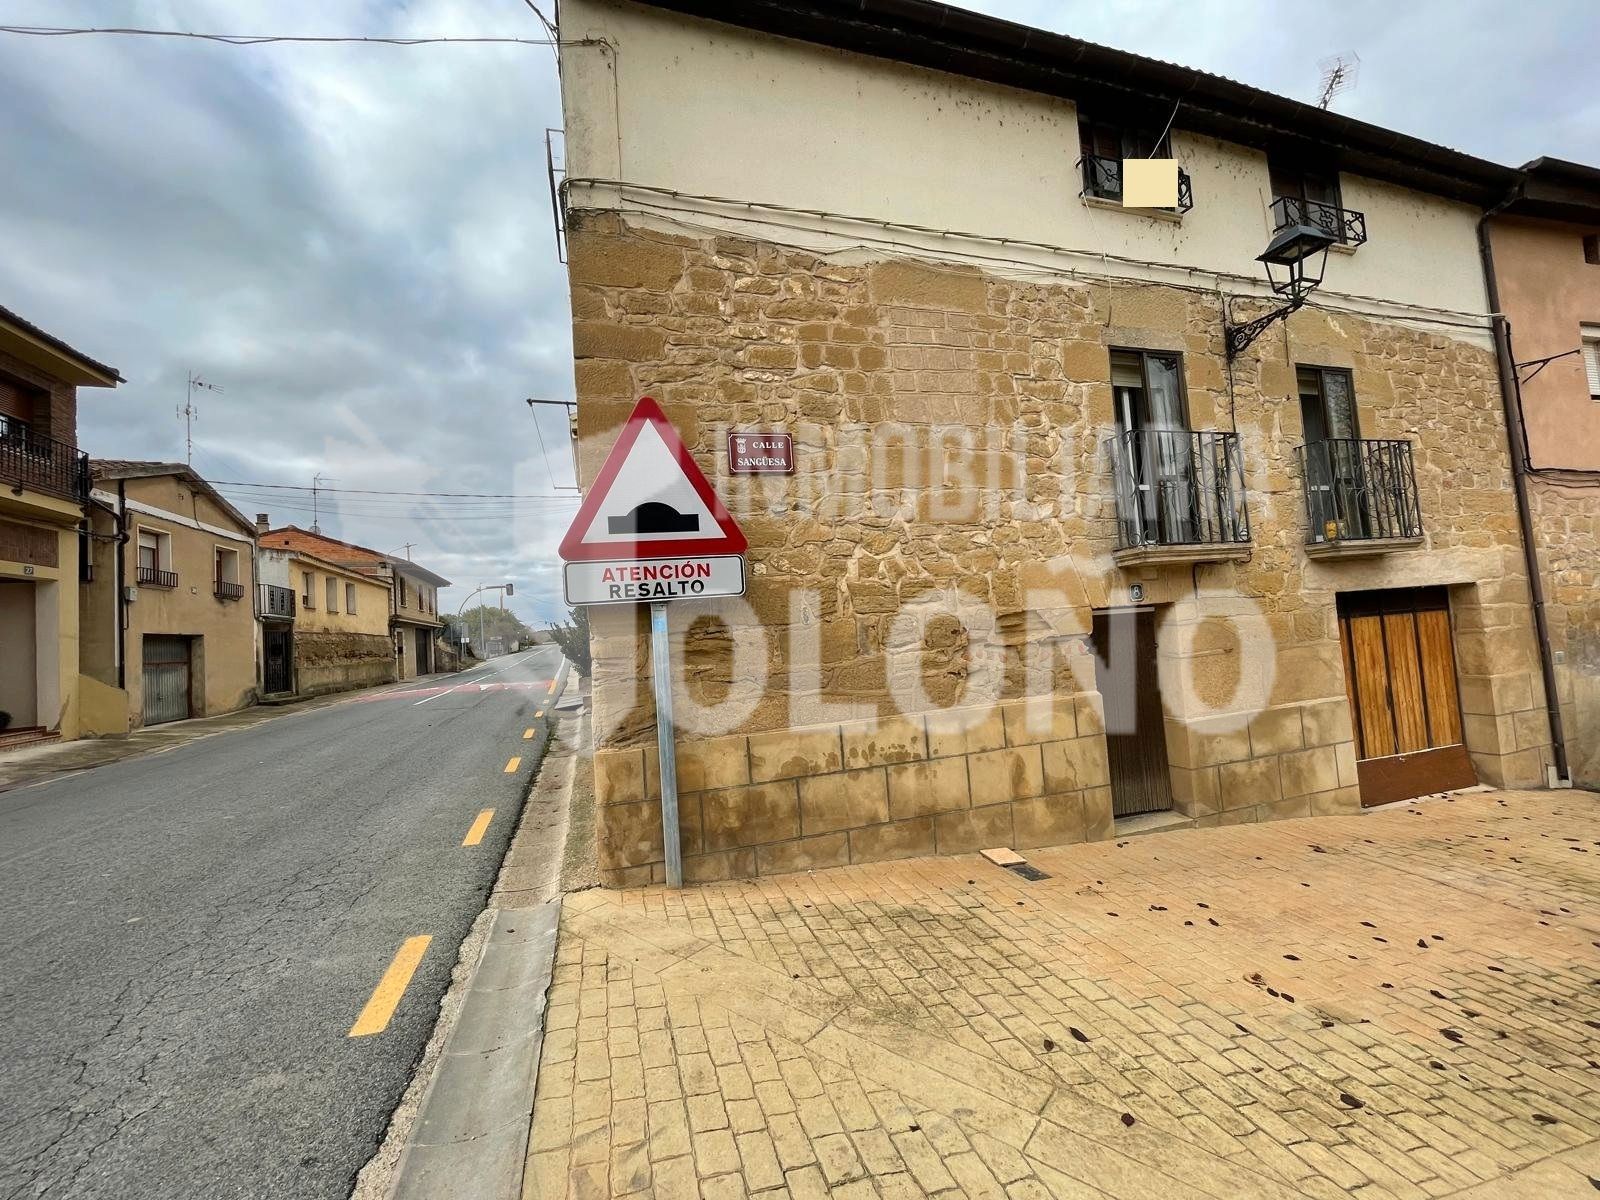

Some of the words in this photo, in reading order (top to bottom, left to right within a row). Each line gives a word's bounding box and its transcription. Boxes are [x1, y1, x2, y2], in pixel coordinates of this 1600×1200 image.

[752, 441, 785, 449] CALLE
[737, 456, 787, 466] SANGÜESA
[602, 561, 712, 583] ATENCIÓN
[609, 579, 705, 599] RESALTO
[1133, 586, 1141, 598] 8
